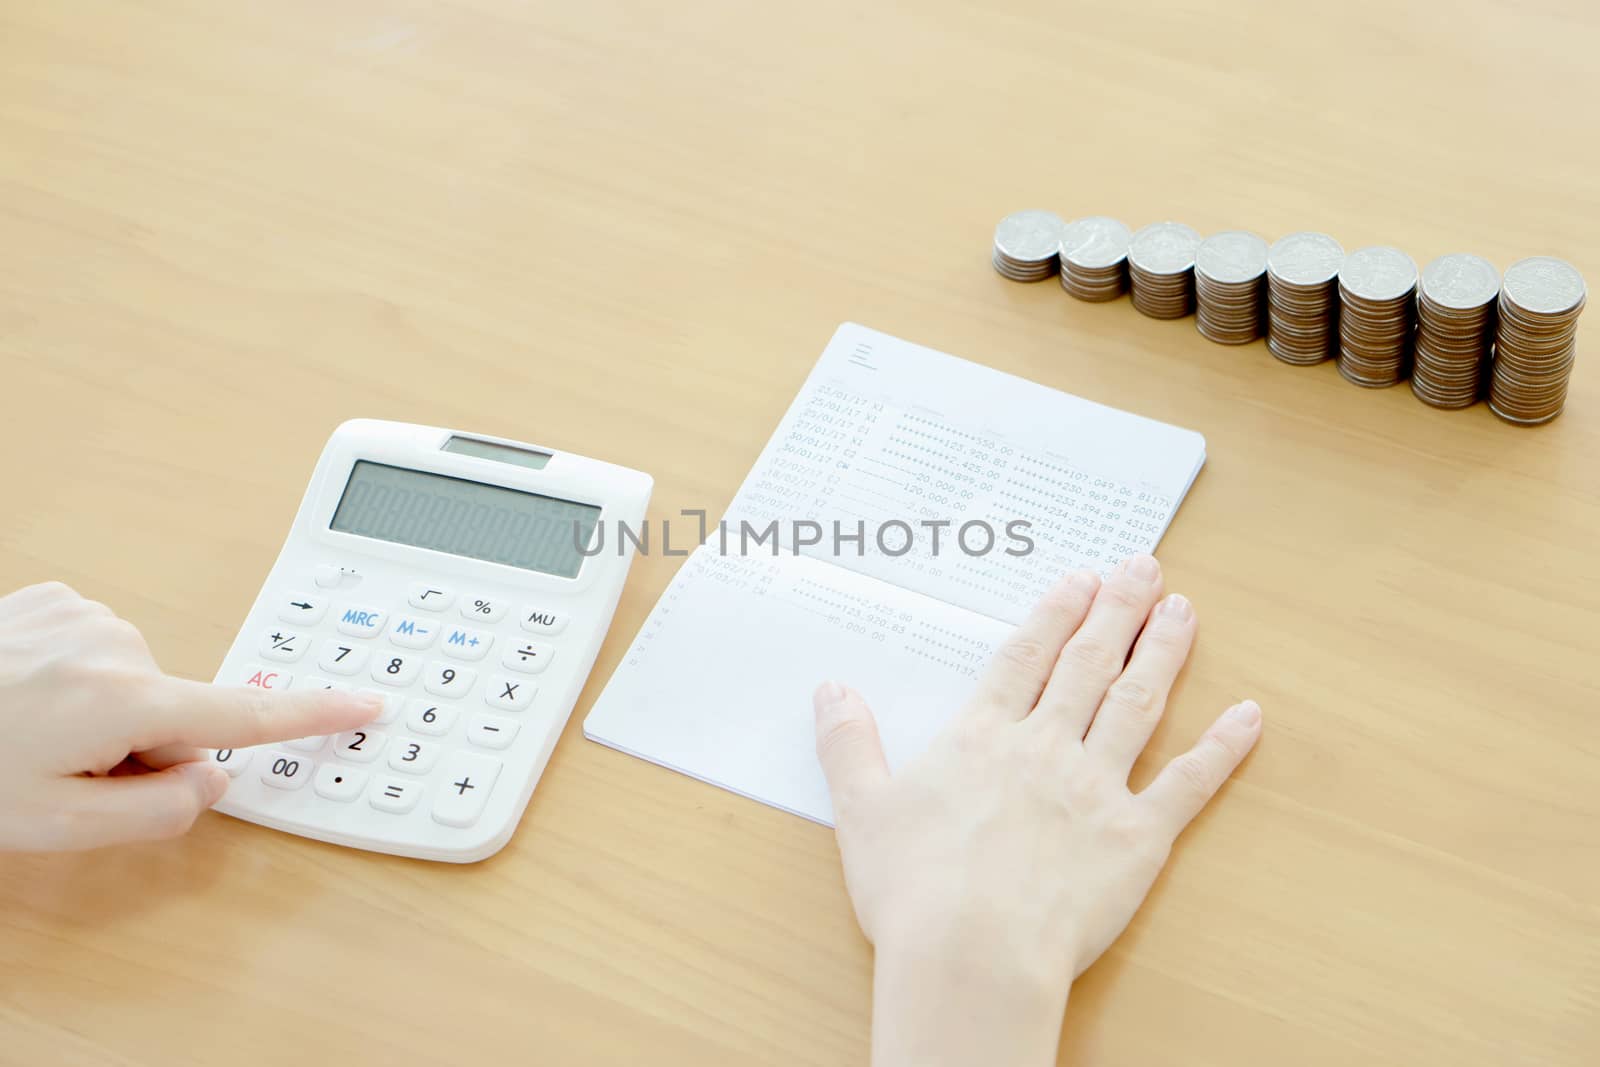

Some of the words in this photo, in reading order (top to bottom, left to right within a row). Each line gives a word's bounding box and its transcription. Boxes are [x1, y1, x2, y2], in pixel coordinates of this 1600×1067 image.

[342, 609, 380, 627] MRC
[529, 612, 556, 627] MU
[449, 631, 480, 647] M+
[335, 646, 352, 662] 7
[386, 658, 403, 675] 8
[248, 671, 278, 689] AC
[441, 669, 456, 685] 9
[422, 707, 437, 723] 6
[347, 732, 367, 751] 2
[402, 743, 421, 762] 3
[271, 758, 300, 778] 00
